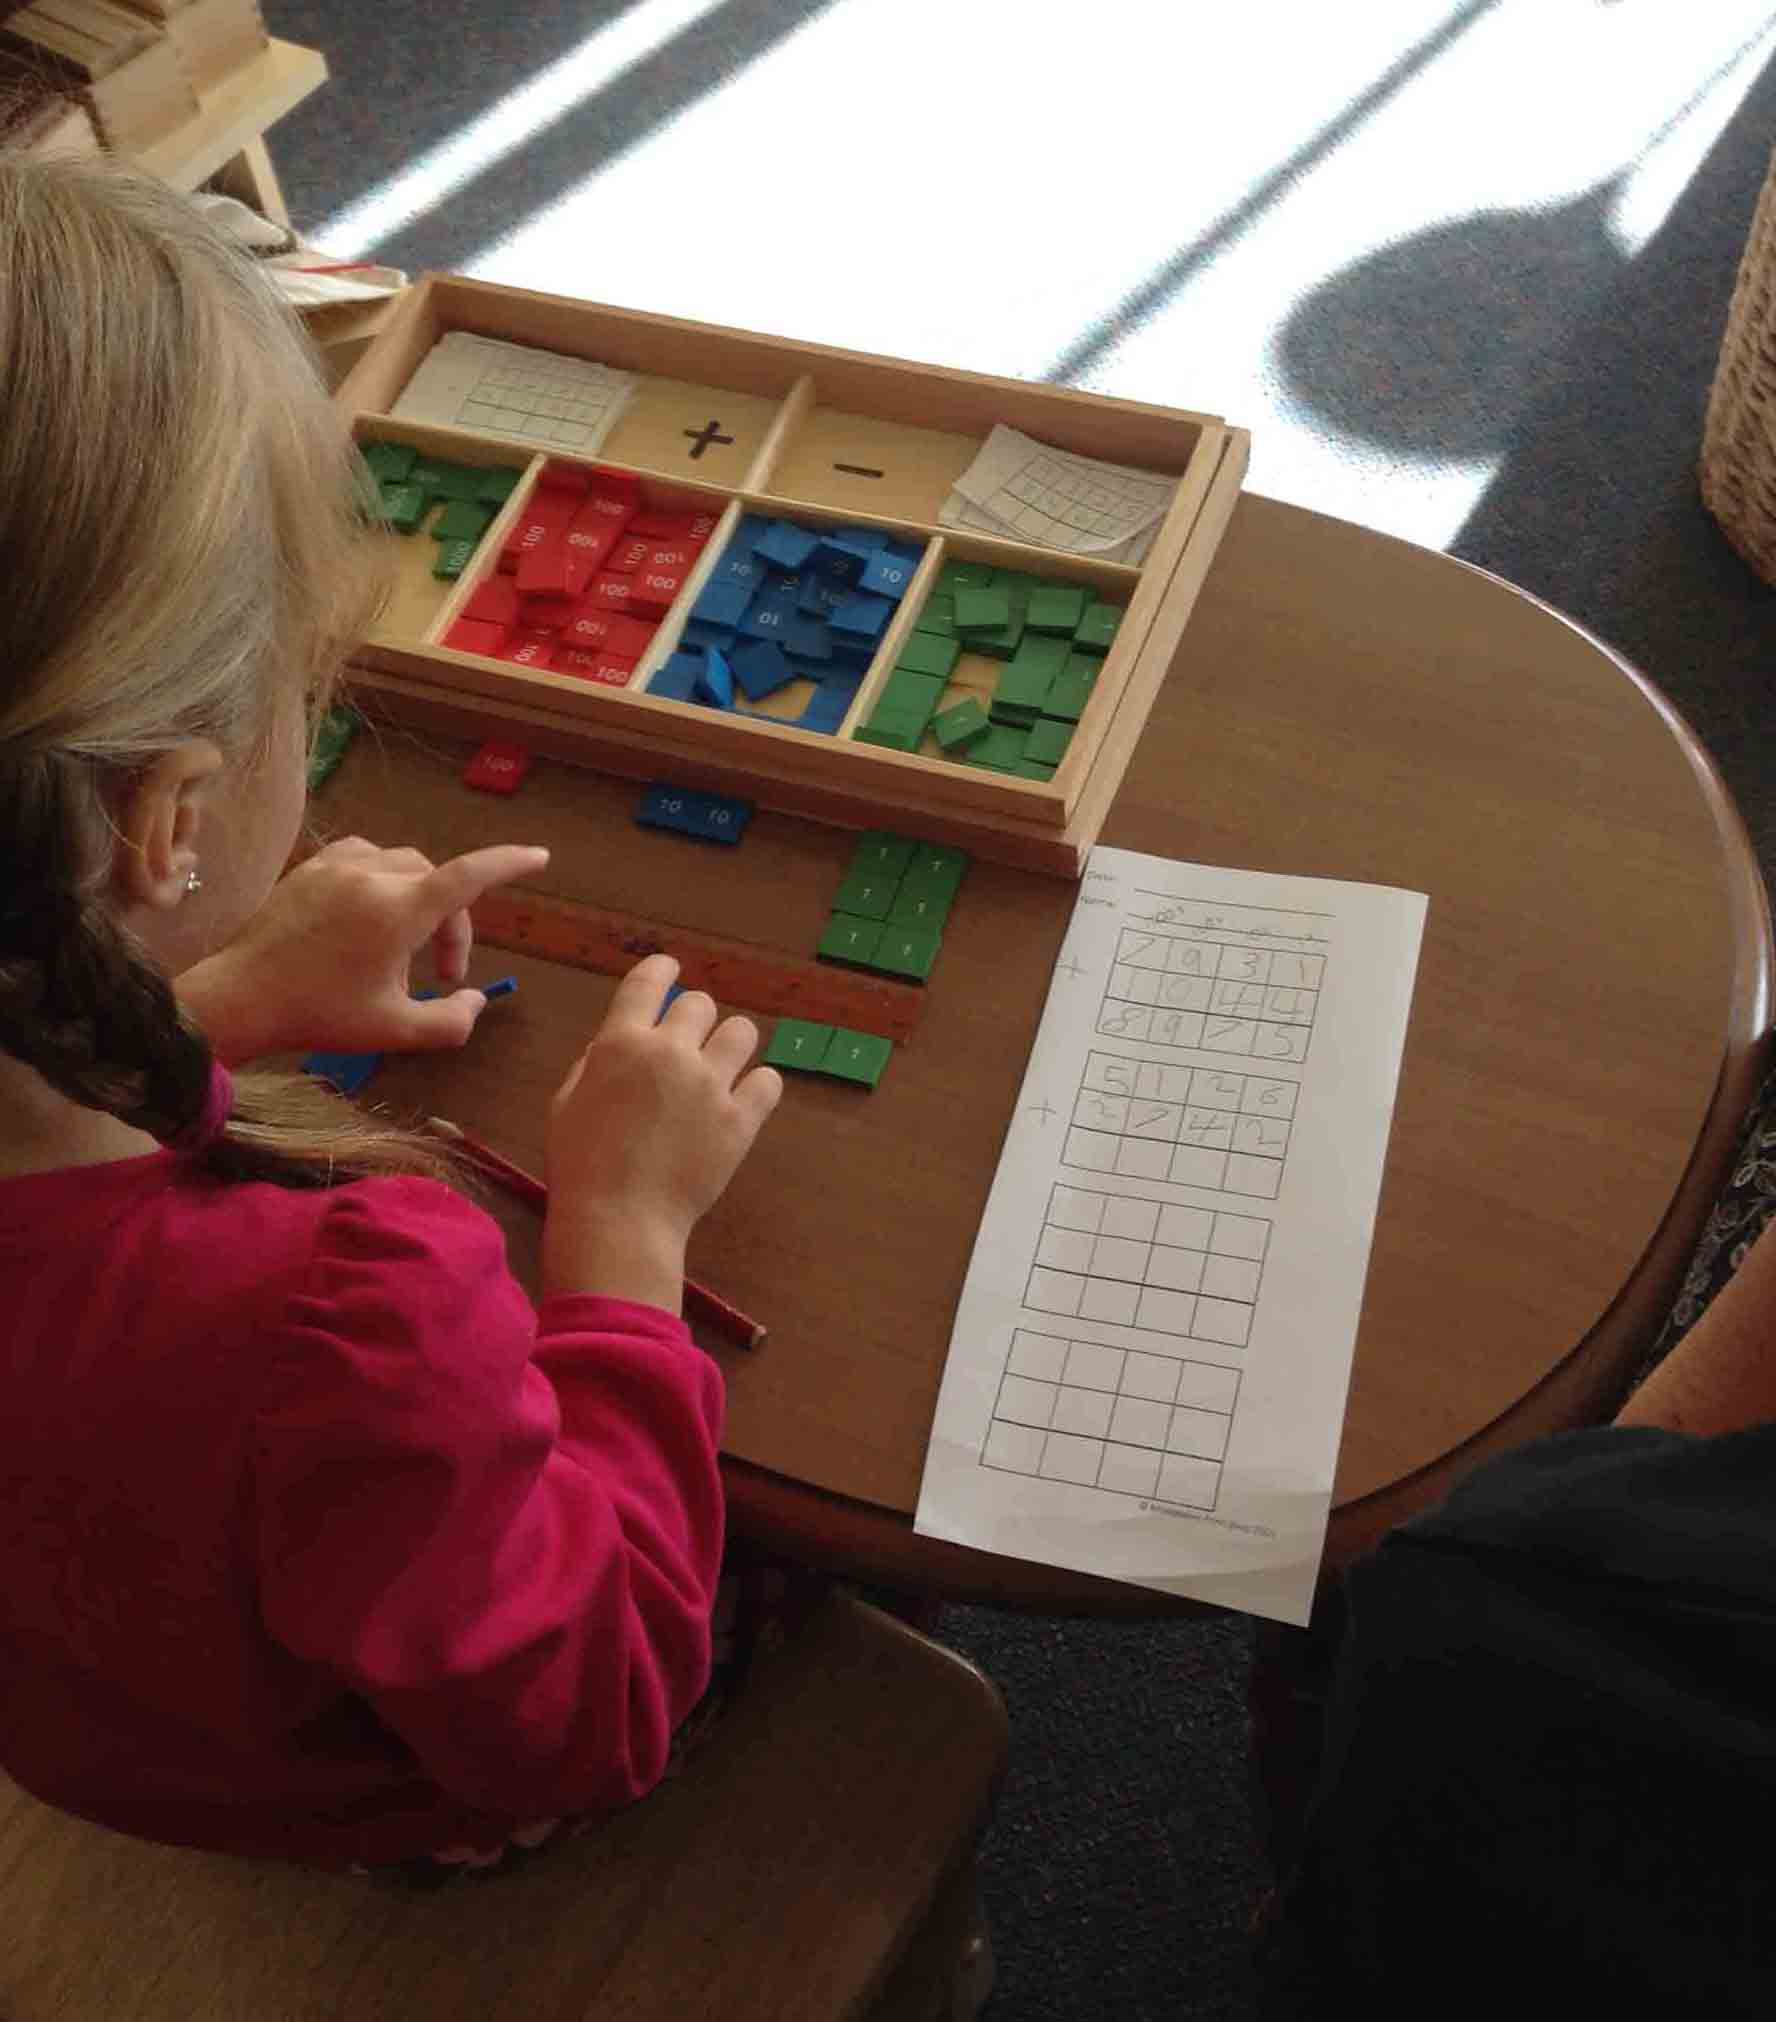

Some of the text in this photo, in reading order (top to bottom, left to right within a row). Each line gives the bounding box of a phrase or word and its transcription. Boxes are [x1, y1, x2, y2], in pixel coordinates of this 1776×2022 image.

[522, 525, 545, 549] 100
[624, 542, 648, 567] 100
[653, 551, 685, 566] 100
[729, 560, 751, 577] 10
[880, 567, 902, 585] 10
[600, 582, 630, 598] 100
[646, 574, 677, 591] 100
[575, 619, 607, 636] 100
[759, 611, 781, 627] 10
[481, 754, 513, 774] 100
[657, 799, 731, 825] 10 10
[1240, 953, 1262, 979] 3
